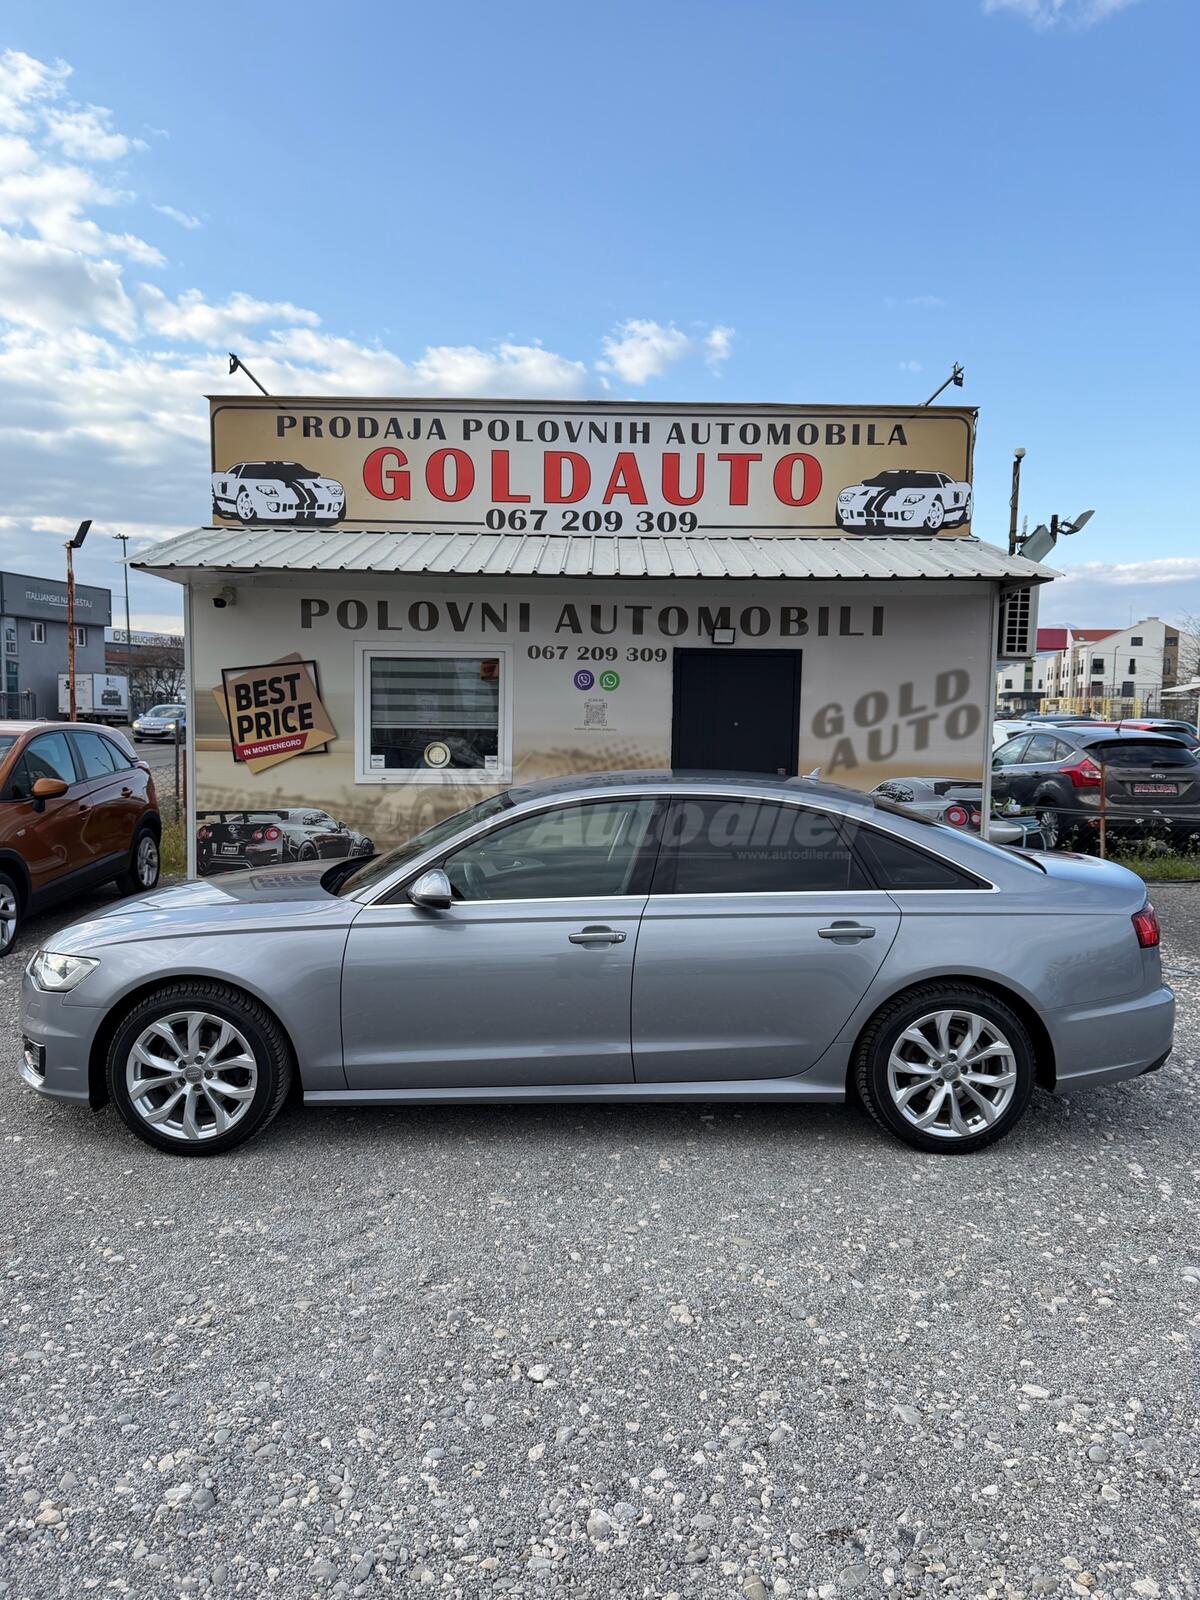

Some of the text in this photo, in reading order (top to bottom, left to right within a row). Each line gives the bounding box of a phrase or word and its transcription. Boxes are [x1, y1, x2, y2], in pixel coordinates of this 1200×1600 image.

[276, 415, 908, 447] PRODAJA POLOVNIH AUTOMOBILA
[362, 446, 823, 507] GOLDAUTO
[485, 508, 699, 533] 067 209 309
[300, 598, 885, 638] POLOVNI AUTOMOBILI
[527, 645, 668, 663] 067 209 309
[235, 672, 301, 712] BEST
[811, 668, 970, 740] GOLD
[236, 702, 314, 743] PRICE
[825, 702, 981, 776] AUTO
[243, 738, 302, 756] IN MONTENEGRO
